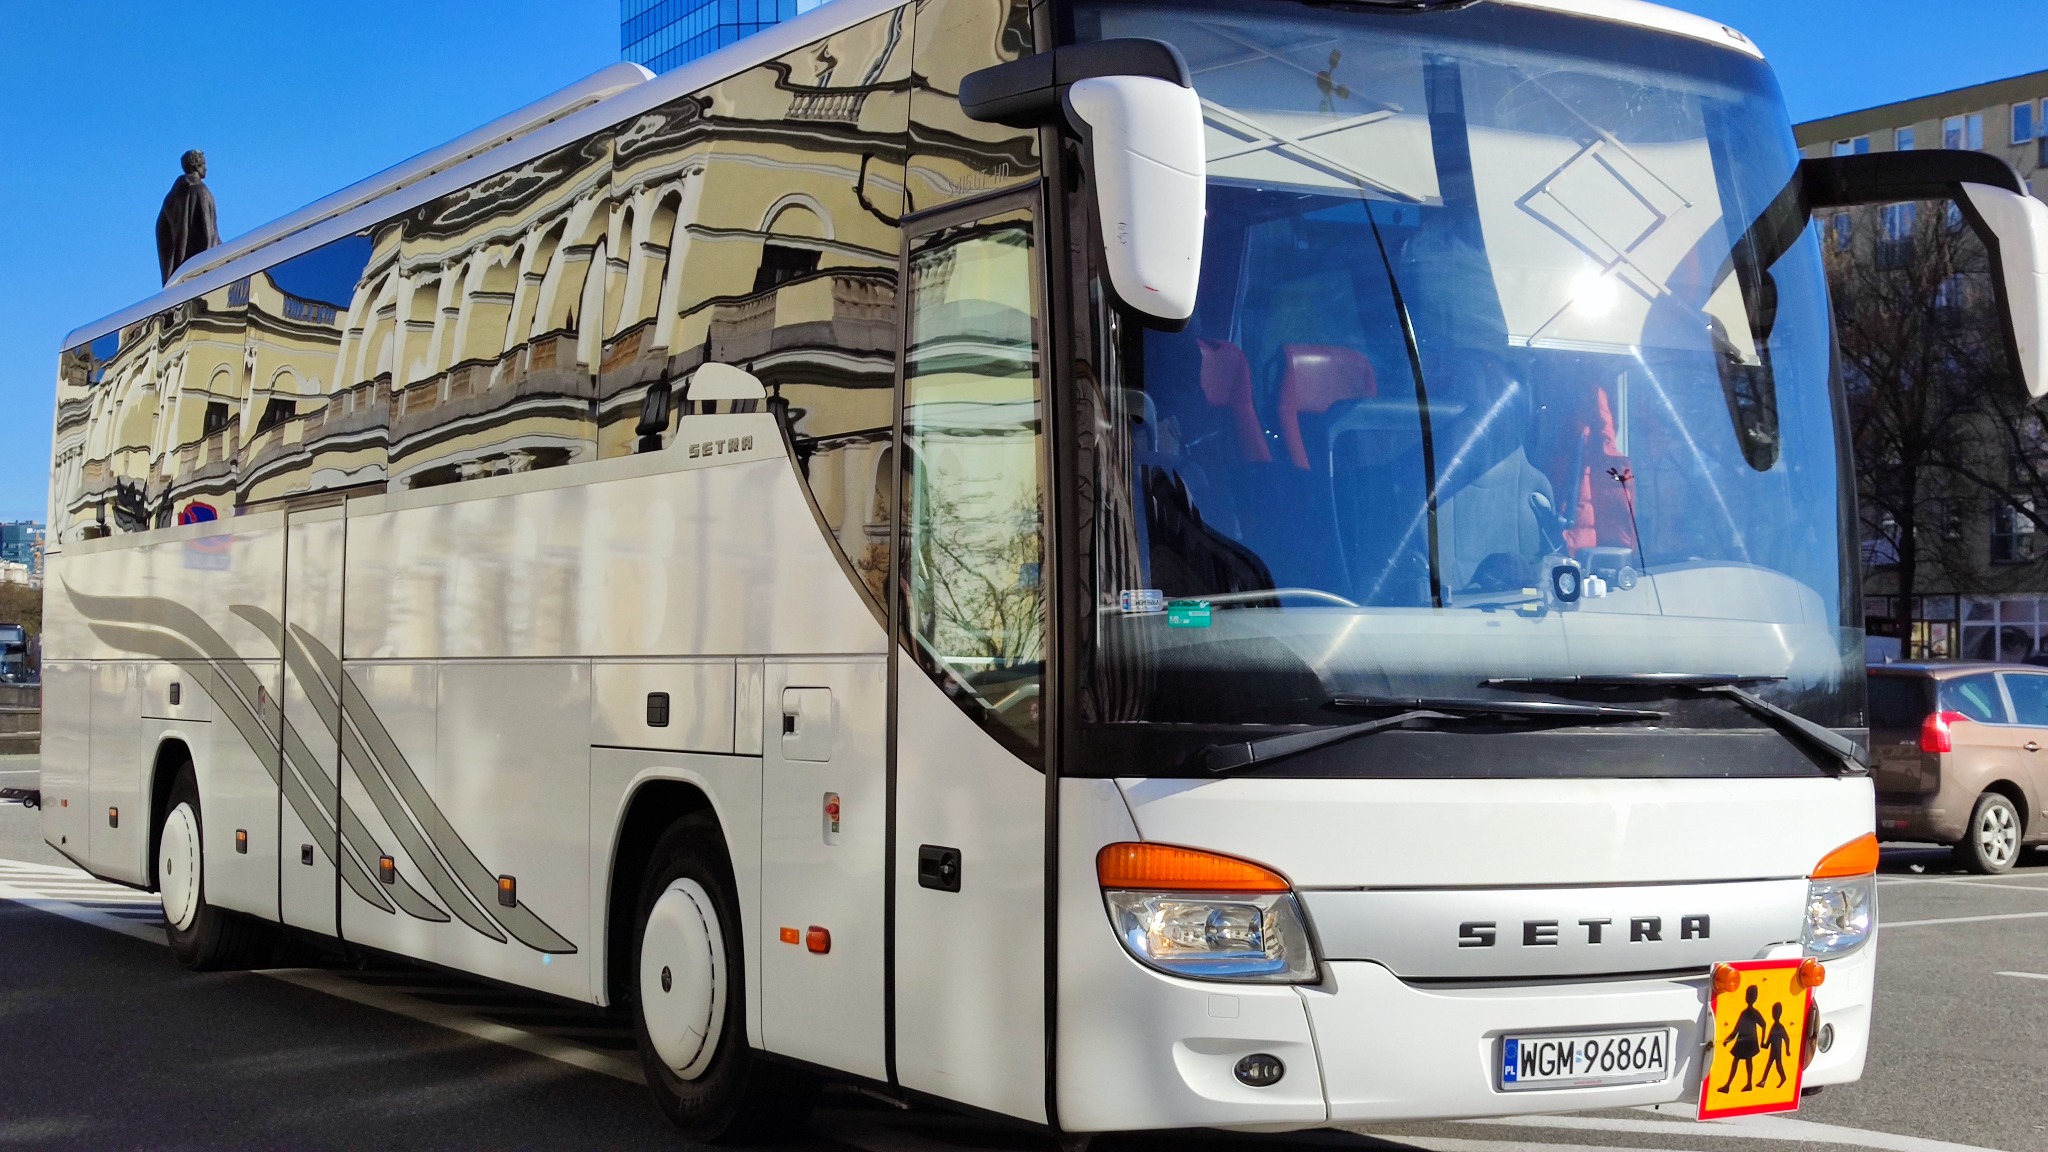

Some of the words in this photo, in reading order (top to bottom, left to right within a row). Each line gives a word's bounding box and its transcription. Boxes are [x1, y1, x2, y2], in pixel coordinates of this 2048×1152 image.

[688, 435, 753, 459] SETRA
[1458, 913, 1710, 948] SETRA
[1504, 1065, 1516, 1076] PL
[1520, 1040, 1575, 1077] WGM
[1583, 1034, 1663, 1074] 9686A
